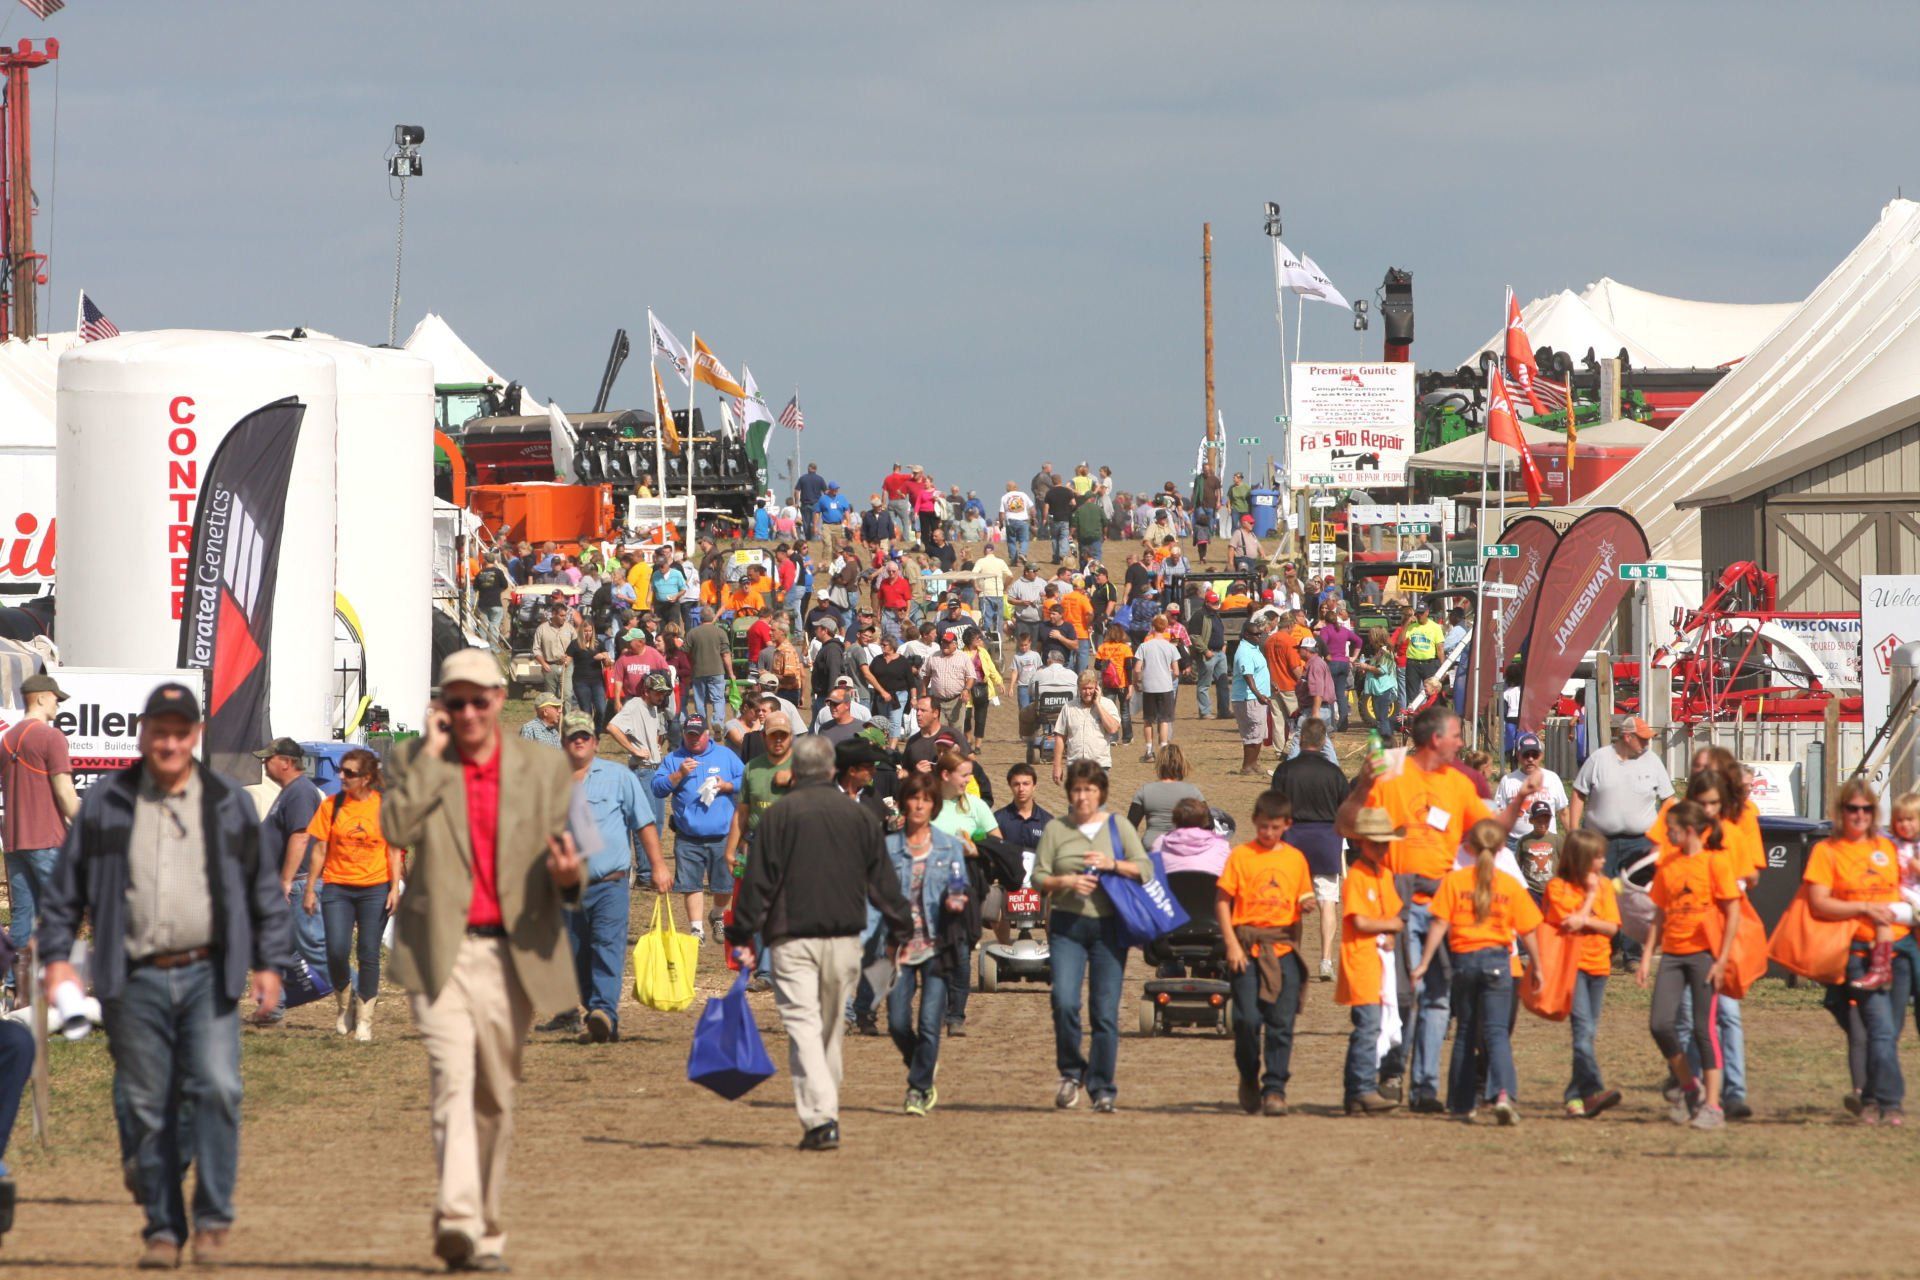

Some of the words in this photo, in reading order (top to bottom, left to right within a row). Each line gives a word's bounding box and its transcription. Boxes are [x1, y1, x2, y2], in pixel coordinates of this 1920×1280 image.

[1310, 366, 1353, 376] Premier
[1359, 366, 1397, 376] Gunite
[1335, 430, 1357, 447] Silo
[1361, 430, 1404, 450] Repair
[1356, 472, 1380, 481] REPAIR
[1312, 524, 1334, 536] AM
[1487, 547, 1498, 556] 5th
[1448, 565, 1481, 583] FAMI
[1628, 566, 1642, 577] 4th
[1647, 566, 1659, 577] ST.
[1400, 570, 1431, 588] ATM
[1553, 555, 1614, 656] JAMESWAY
[1780, 620, 1861, 633] WISCONSIN
[53, 704, 142, 737] eller
[67, 741, 94, 751] itects
[1008, 894, 1025, 902] RENT
[1029, 894, 1039, 902] ME
[1011, 902, 1036, 911] VISTA
